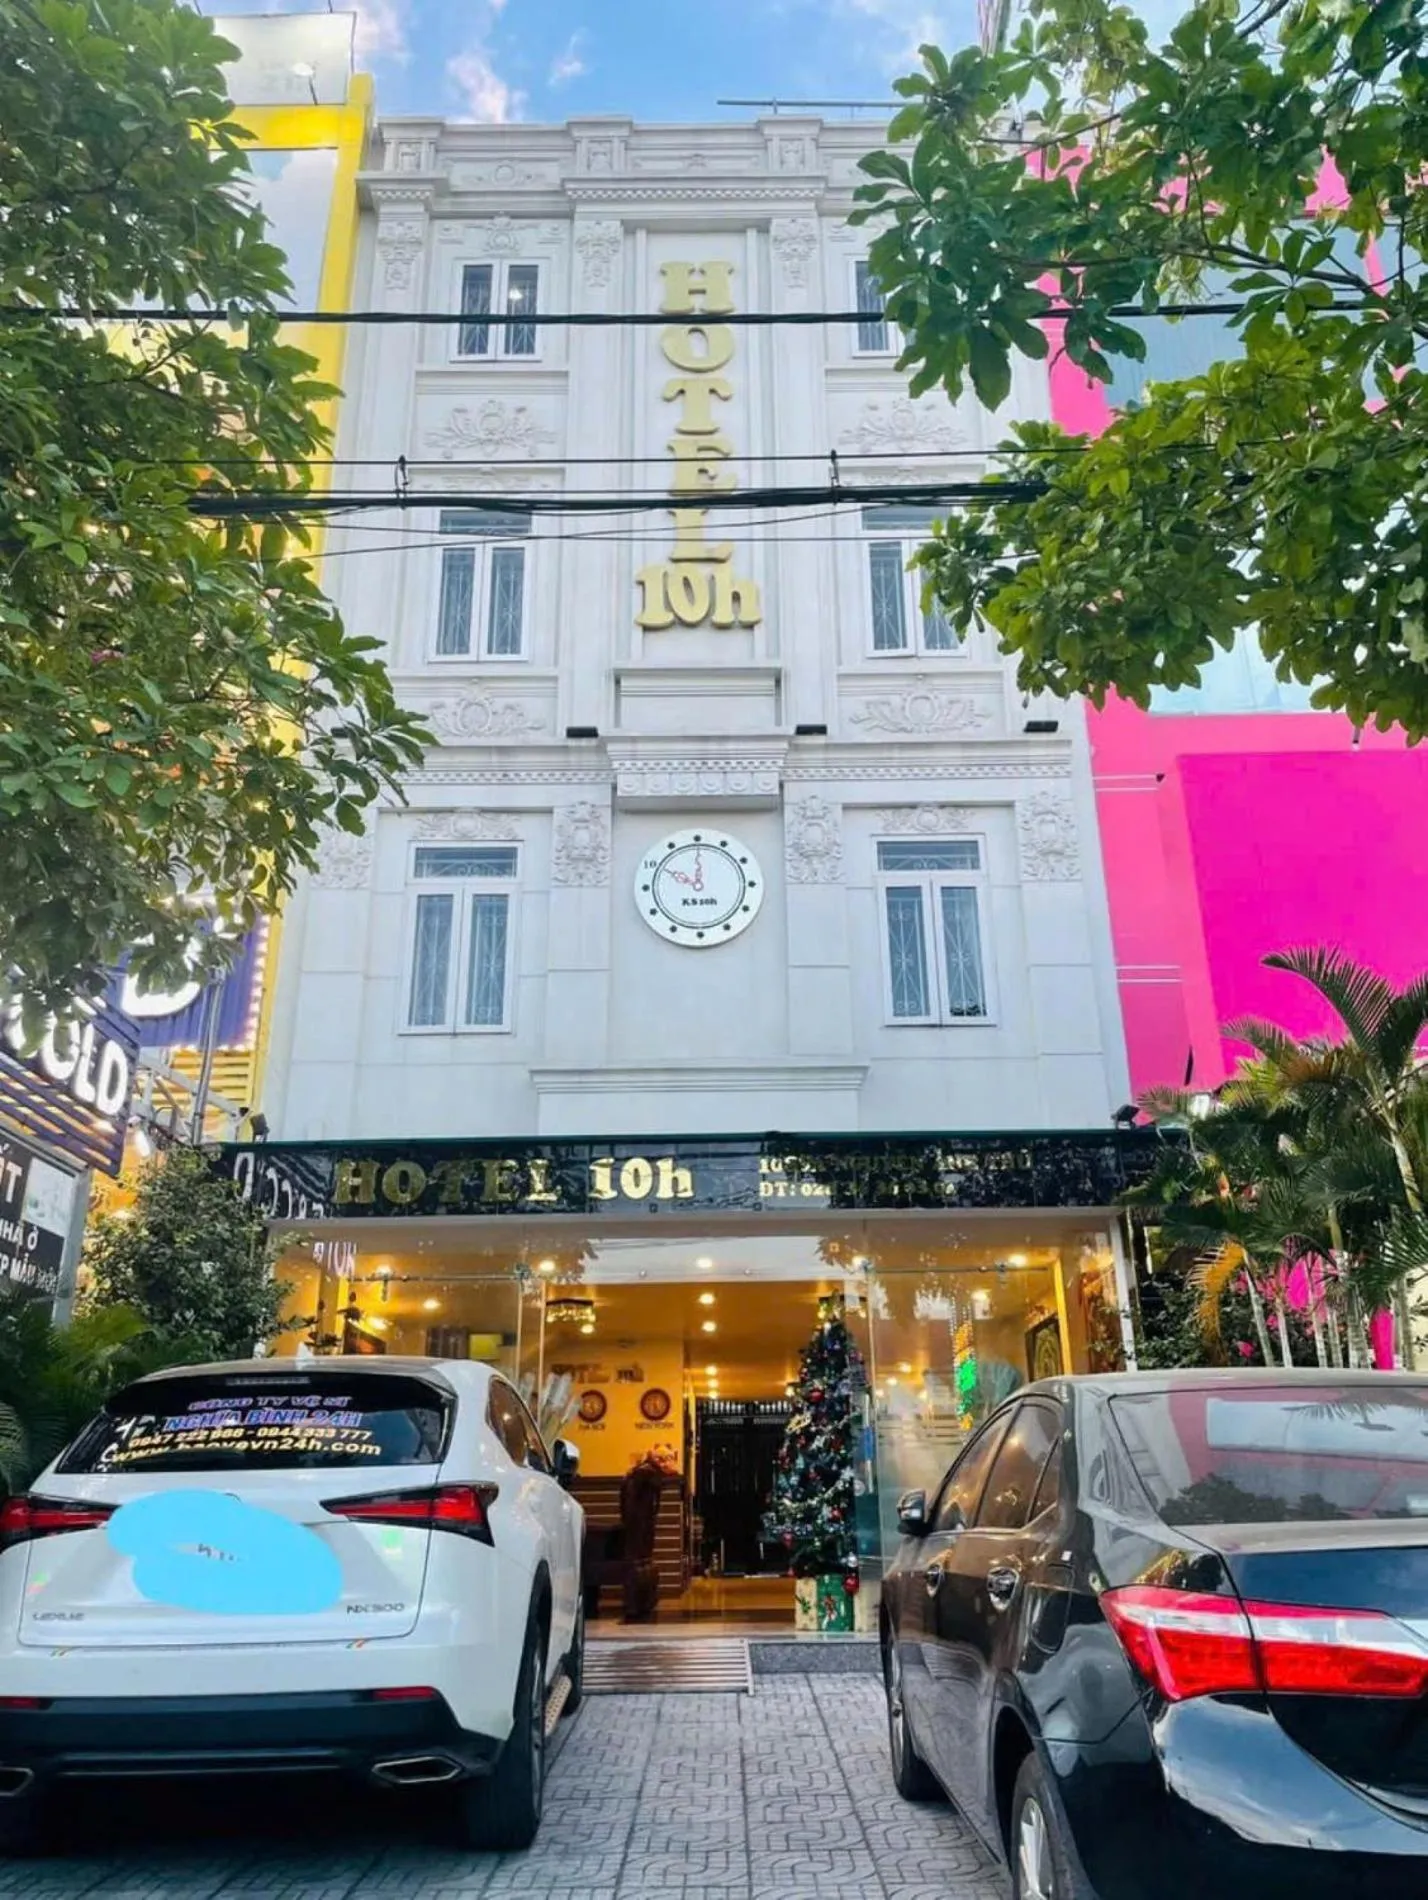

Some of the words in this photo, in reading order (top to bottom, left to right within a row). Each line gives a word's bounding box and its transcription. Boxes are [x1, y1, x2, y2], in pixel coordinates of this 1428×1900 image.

[659, 260, 738, 563] HOTEL
[634, 562, 761, 630] 10h
[643, 859, 658, 869] 10
[332, 1157, 563, 1204] HOTEL
[340, 1429, 373, 1441] 777
